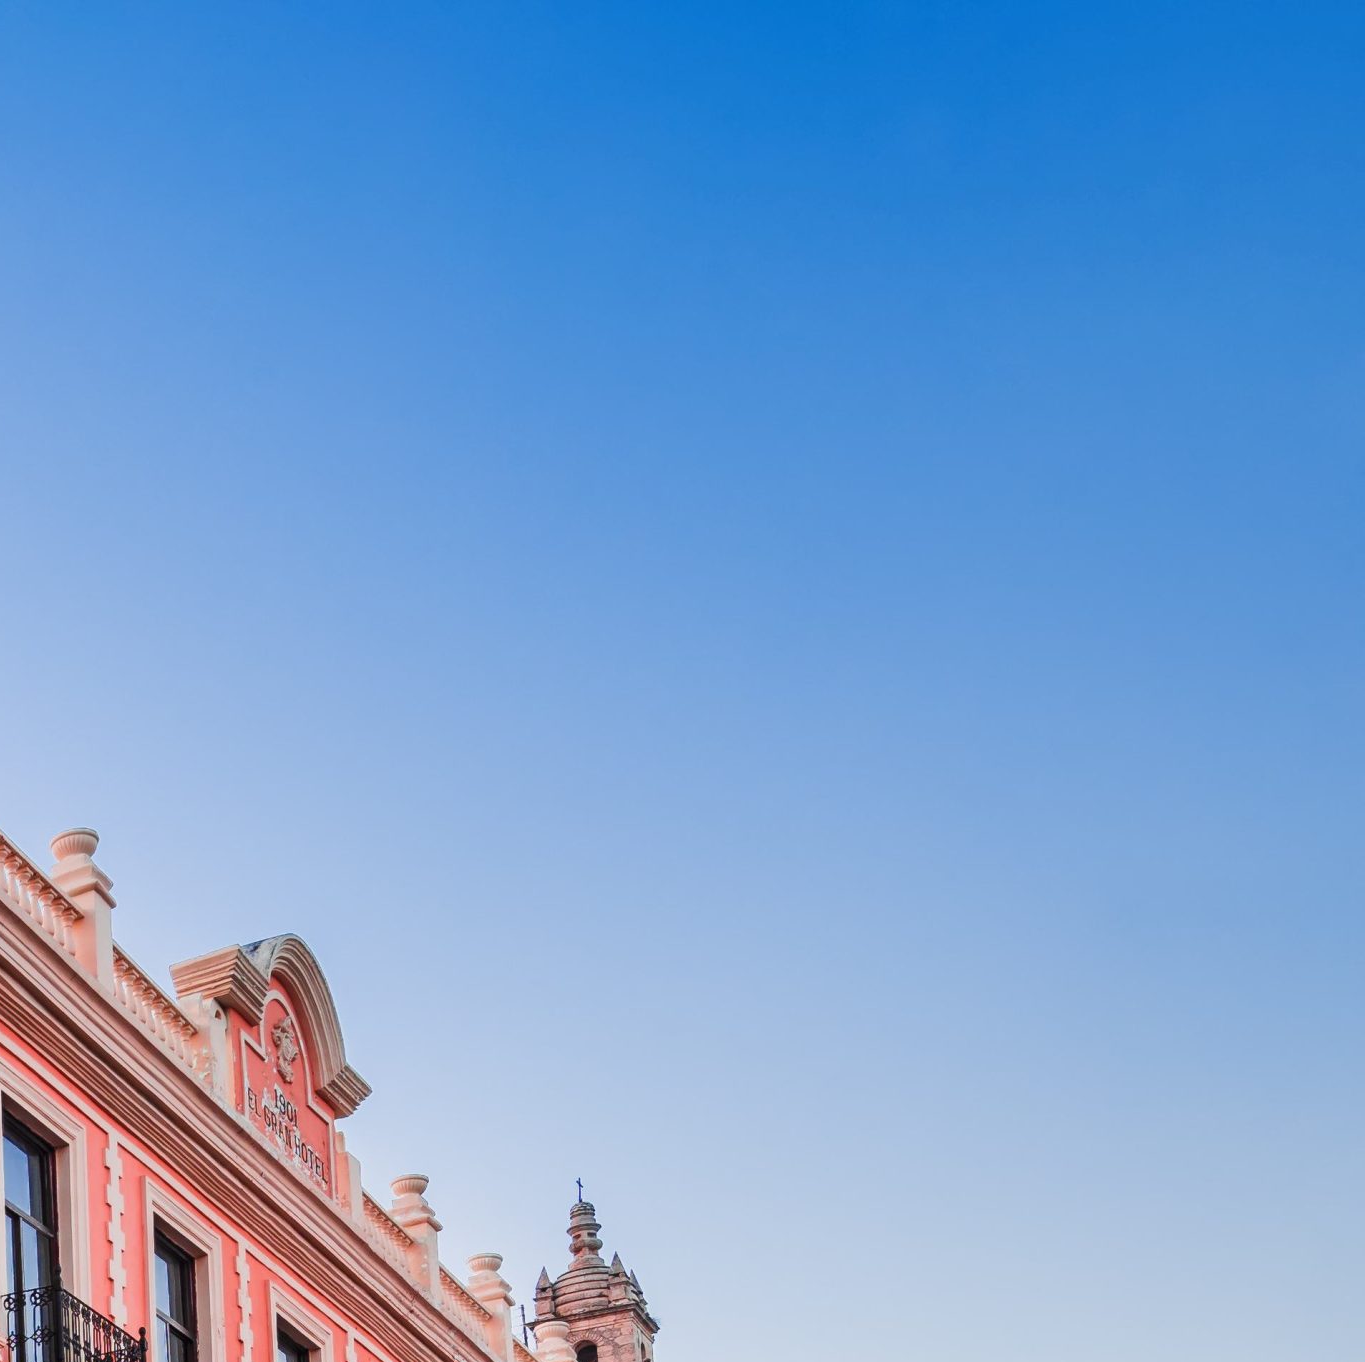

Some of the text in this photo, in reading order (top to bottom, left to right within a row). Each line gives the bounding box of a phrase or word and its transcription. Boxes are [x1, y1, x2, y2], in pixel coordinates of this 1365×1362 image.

[247, 1087, 328, 1184] EL GRAN HOTEL
[274, 1088, 298, 1128] 1901
